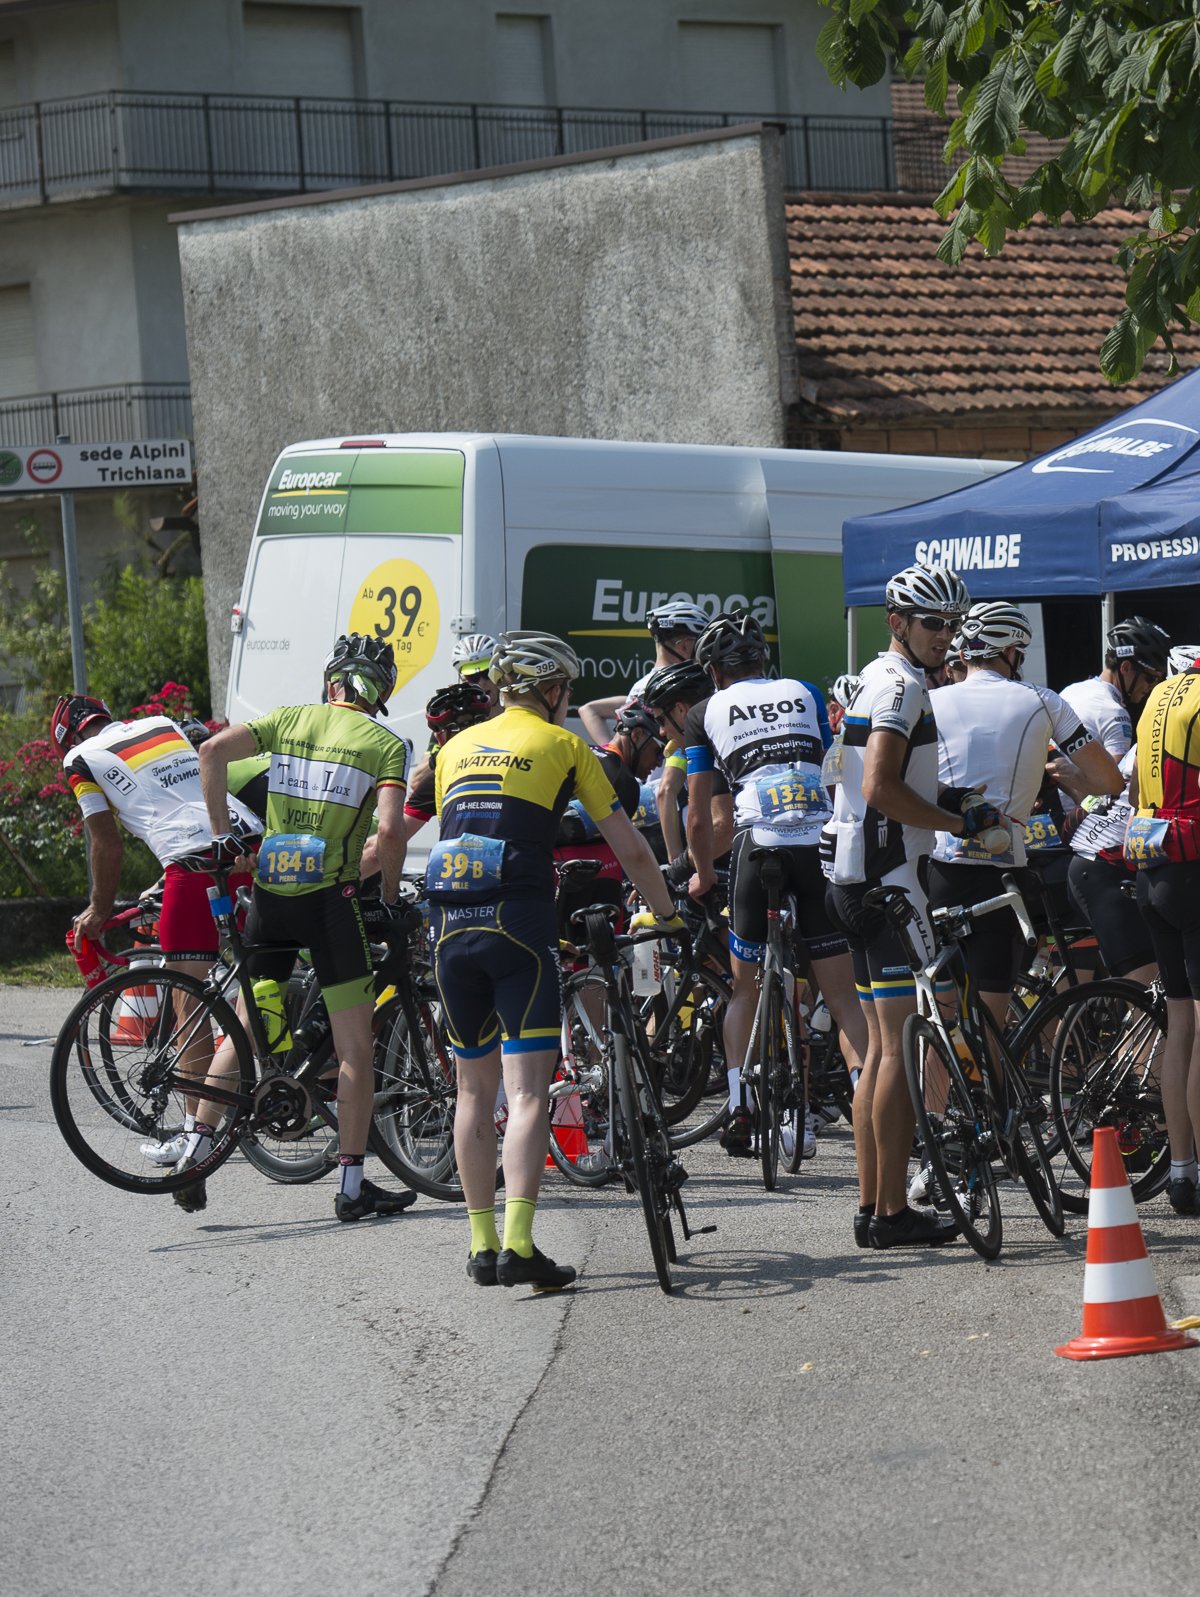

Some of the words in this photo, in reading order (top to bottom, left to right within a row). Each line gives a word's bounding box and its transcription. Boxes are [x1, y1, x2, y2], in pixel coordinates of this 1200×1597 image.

[80, 446, 123, 461] sede
[129, 443, 185, 461] Alpini
[97, 466, 186, 482] Trichiana
[278, 469, 342, 495] Europcar
[268, 504, 299, 519] moving
[300, 504, 323, 518] your
[323, 503, 346, 517] way
[914, 534, 1021, 570] SCHWALBE
[362, 588, 374, 599] Ab
[374, 586, 422, 638] 39
[247, 638, 289, 651] europcar.de
[396, 639, 412, 653] Tag
[535, 661, 556, 675] 39B
[1172, 677, 1196, 707] RSG
[728, 697, 806, 727] Argos
[733, 726, 768, 742] Packaging
[778, 722, 811, 730] Protection
[295, 741, 325, 752] ARDEUR
[325, 746, 363, 758] D'AVANCE
[742, 748, 760, 760] van
[152, 763, 172, 776] Team
[160, 767, 201, 788] Herma
[107, 769, 132, 792] 311
[277, 762, 308, 789] Team
[322, 770, 351, 797] Lux
[767, 783, 806, 806] 132
[811, 789, 819, 802] A
[1048, 824, 1057, 836] B
[267, 851, 302, 873] 184
[305, 857, 315, 872] B
[441, 853, 468, 879] 39
[472, 861, 483, 878] B
[451, 881, 469, 890] VILLE
[447, 905, 495, 921] MASTER
